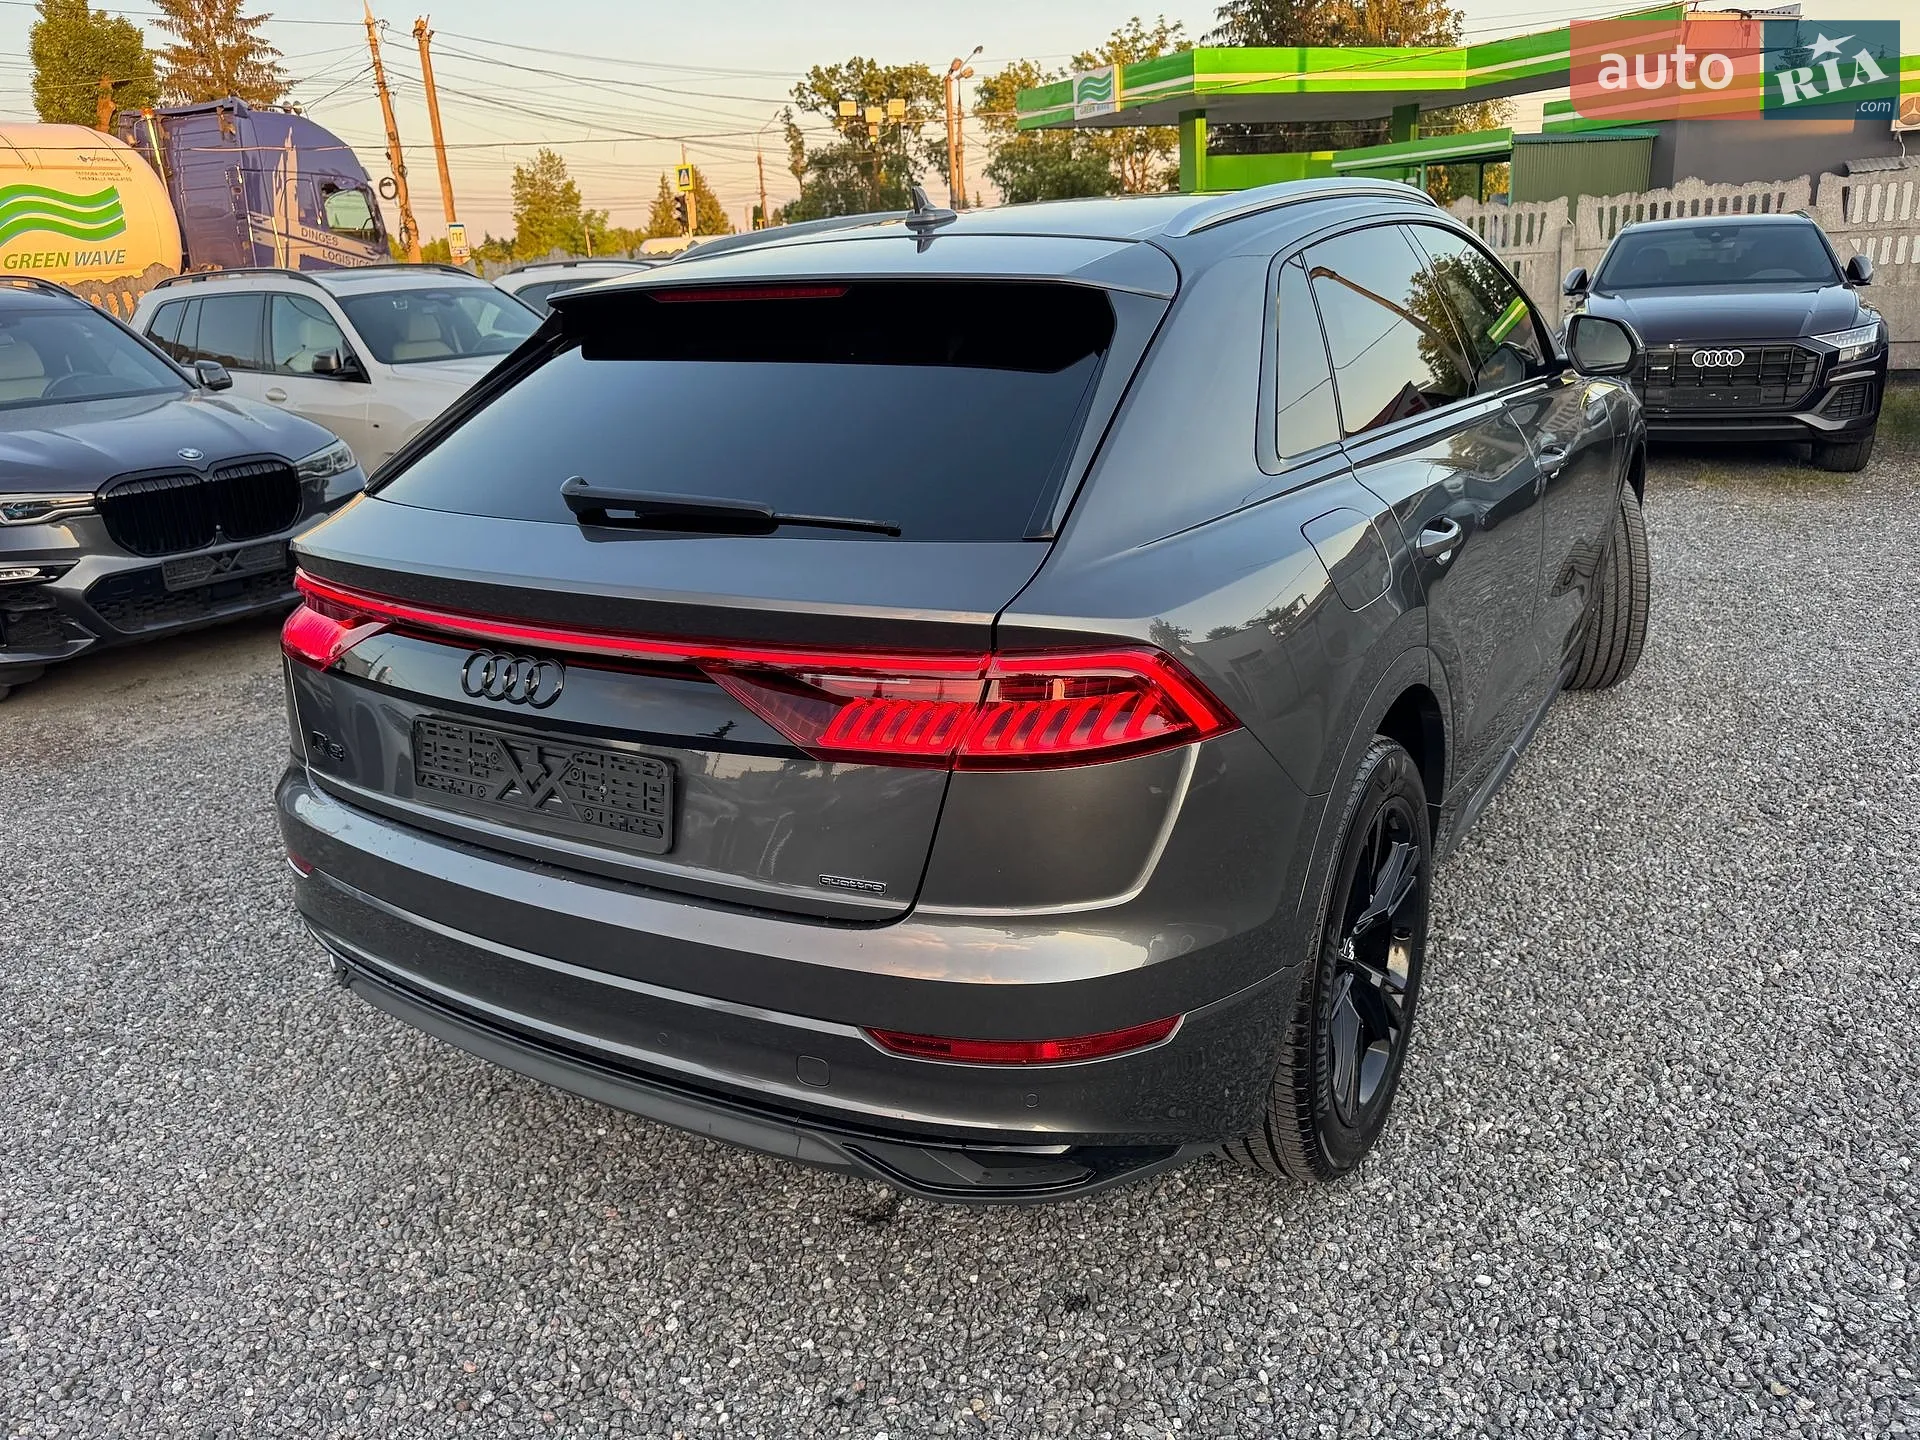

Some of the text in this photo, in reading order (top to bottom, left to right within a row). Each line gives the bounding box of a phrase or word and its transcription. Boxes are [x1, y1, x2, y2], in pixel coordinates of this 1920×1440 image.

[301, 227, 339, 247] DINGES
[3, 249, 126, 270] GREEN WAVE
[821, 877, 883, 891] quattro
